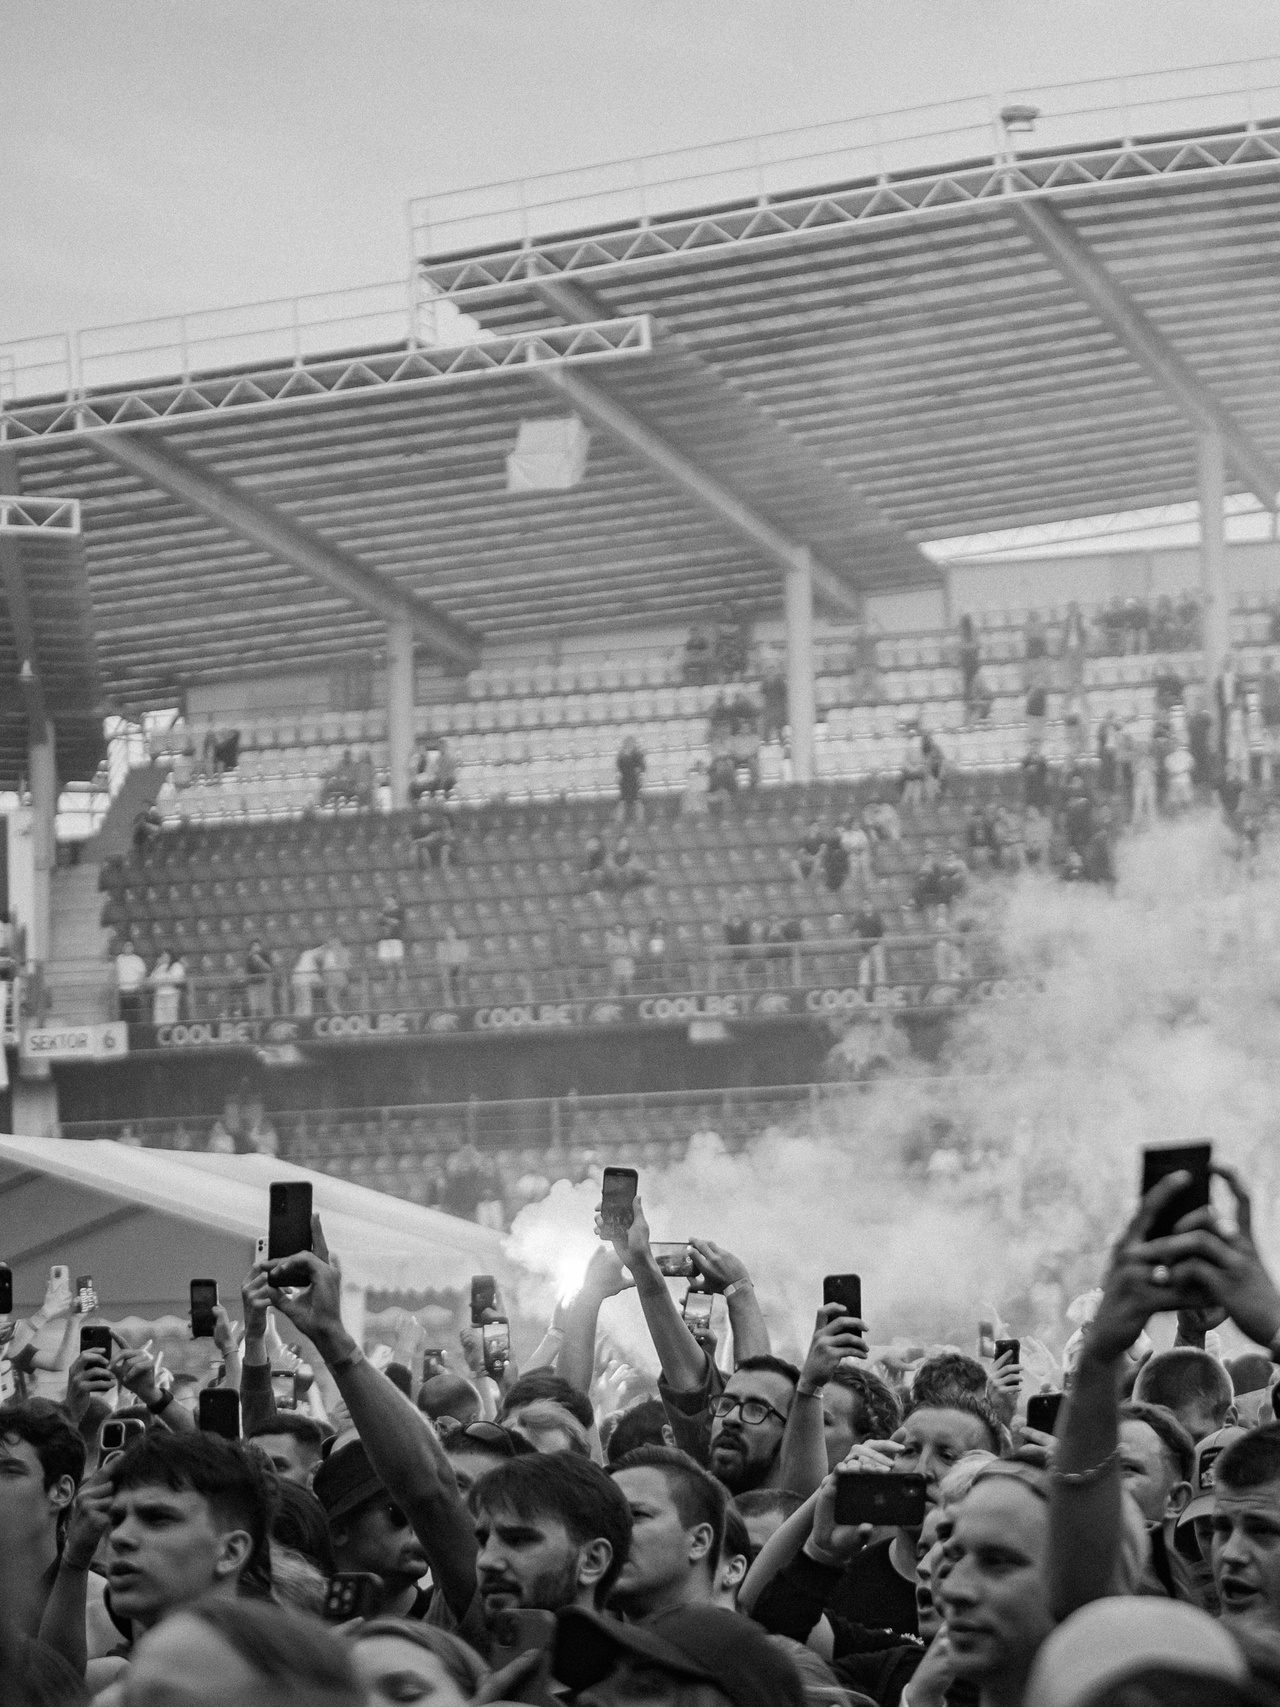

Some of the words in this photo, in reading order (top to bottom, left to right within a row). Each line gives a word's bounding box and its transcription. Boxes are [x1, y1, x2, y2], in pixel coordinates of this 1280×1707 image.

[639, 995, 753, 1020] COOLBET
[806, 986, 922, 1012] COOLBET
[314, 1013, 424, 1037] COOLBET
[475, 1004, 588, 1030] COOLBET
[30, 1033, 88, 1051] SEKTOR
[103, 1030, 116, 1049] 6
[157, 1022, 264, 1045] COOLBET
